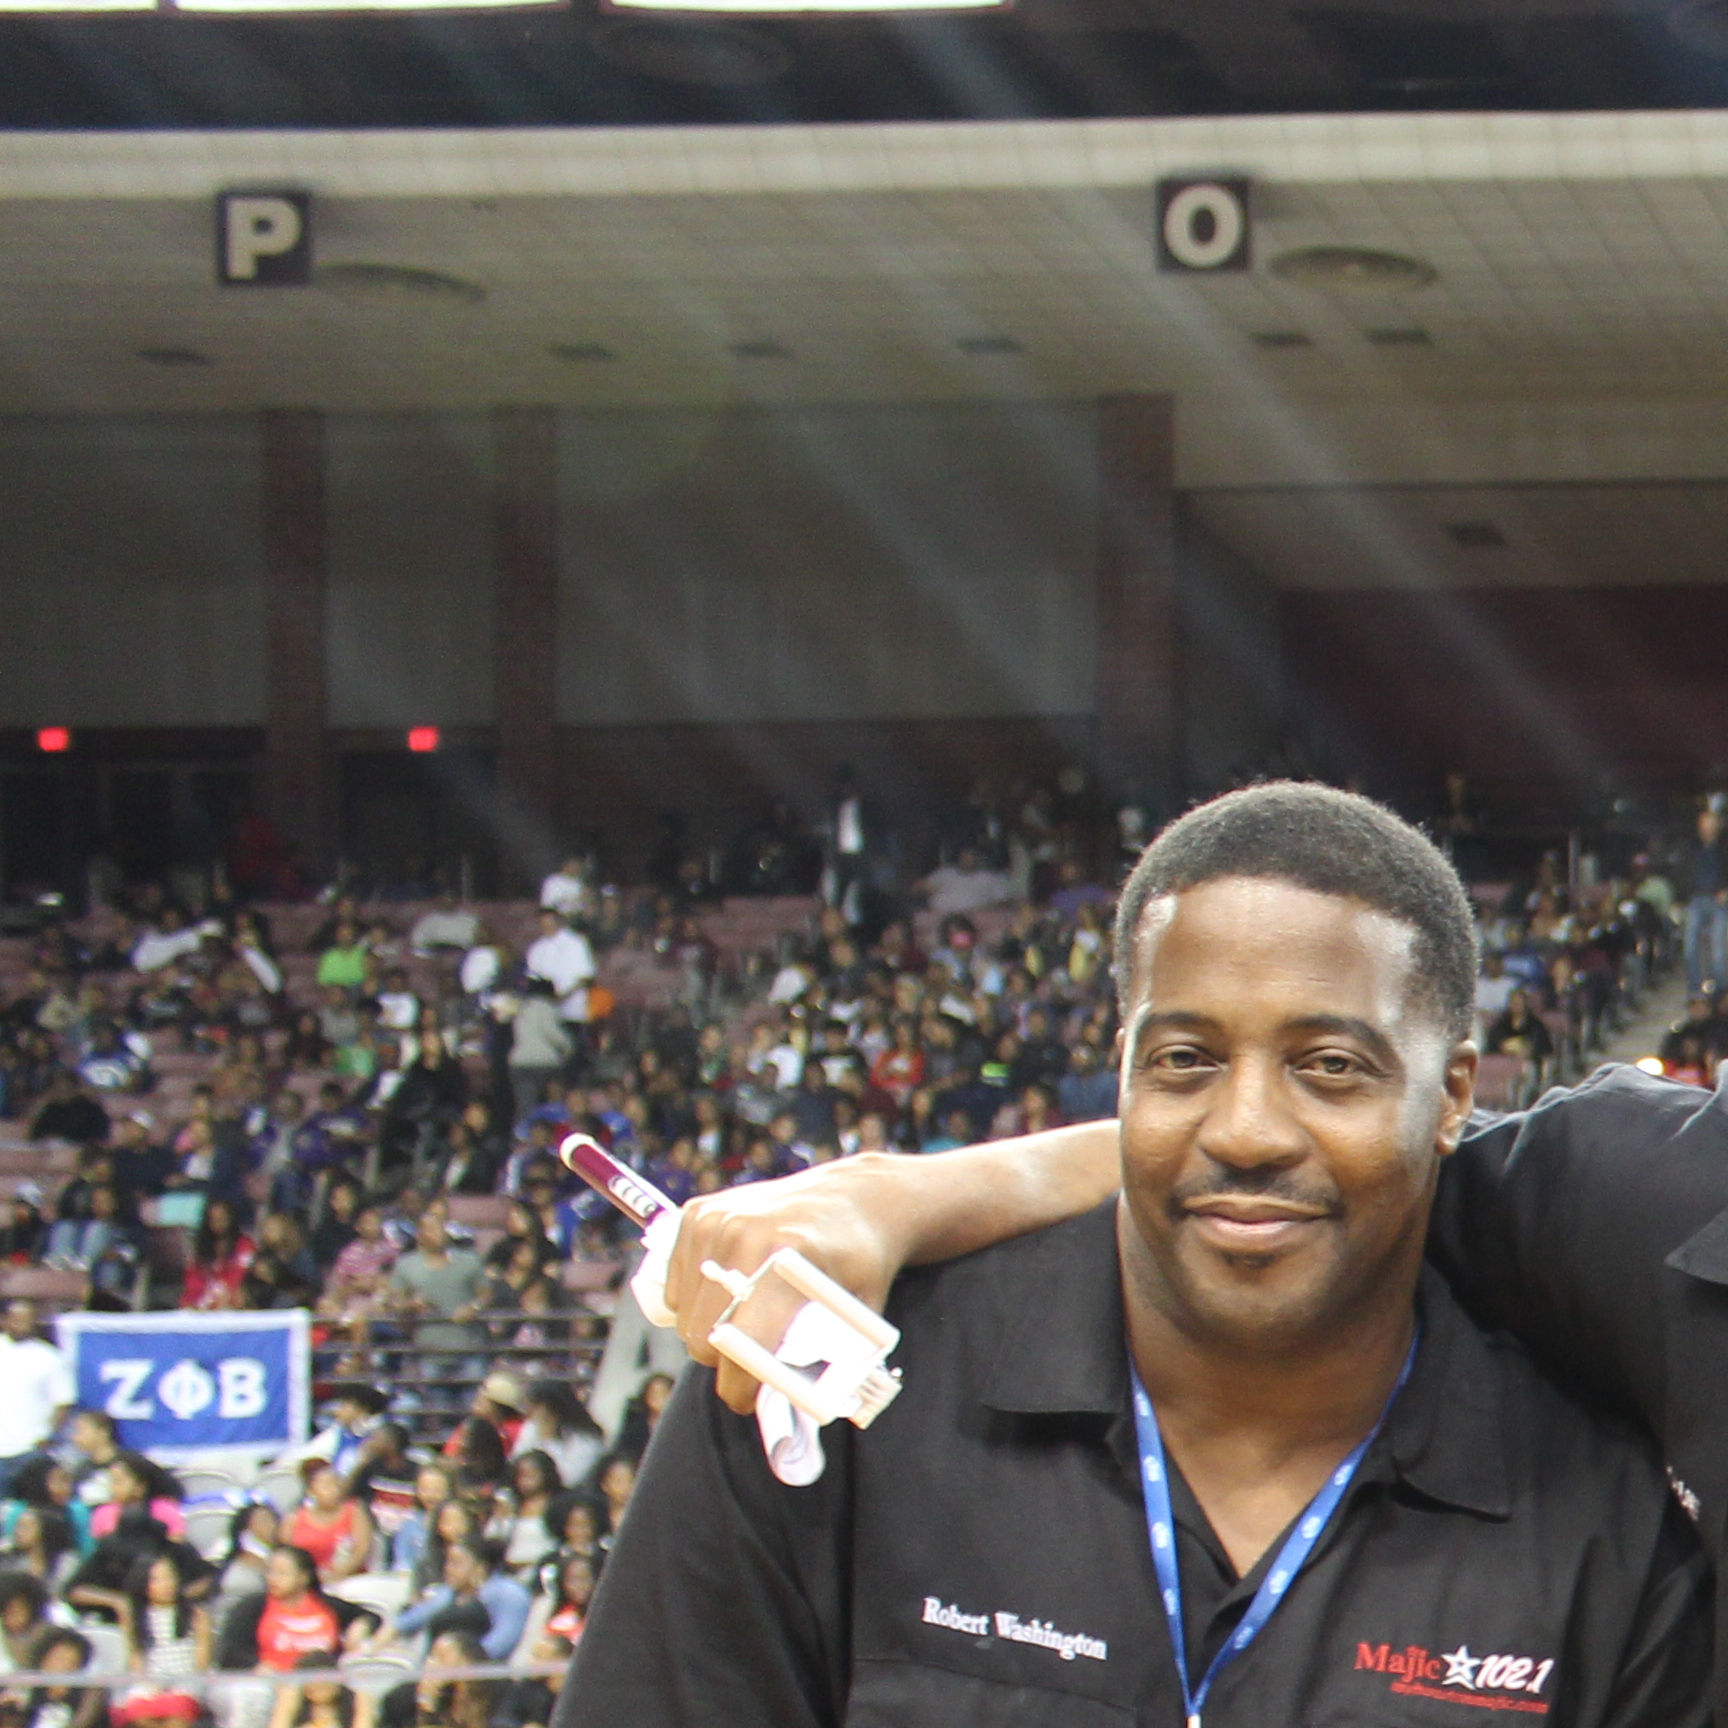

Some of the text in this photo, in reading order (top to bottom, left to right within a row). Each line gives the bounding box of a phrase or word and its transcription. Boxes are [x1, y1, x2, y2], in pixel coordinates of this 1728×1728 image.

[226, 199, 301, 279] P
[1164, 185, 1244, 268] O
[921, 1596, 1108, 1660] Robert Washington
[1354, 1641, 1555, 1694] Majic 102.1
